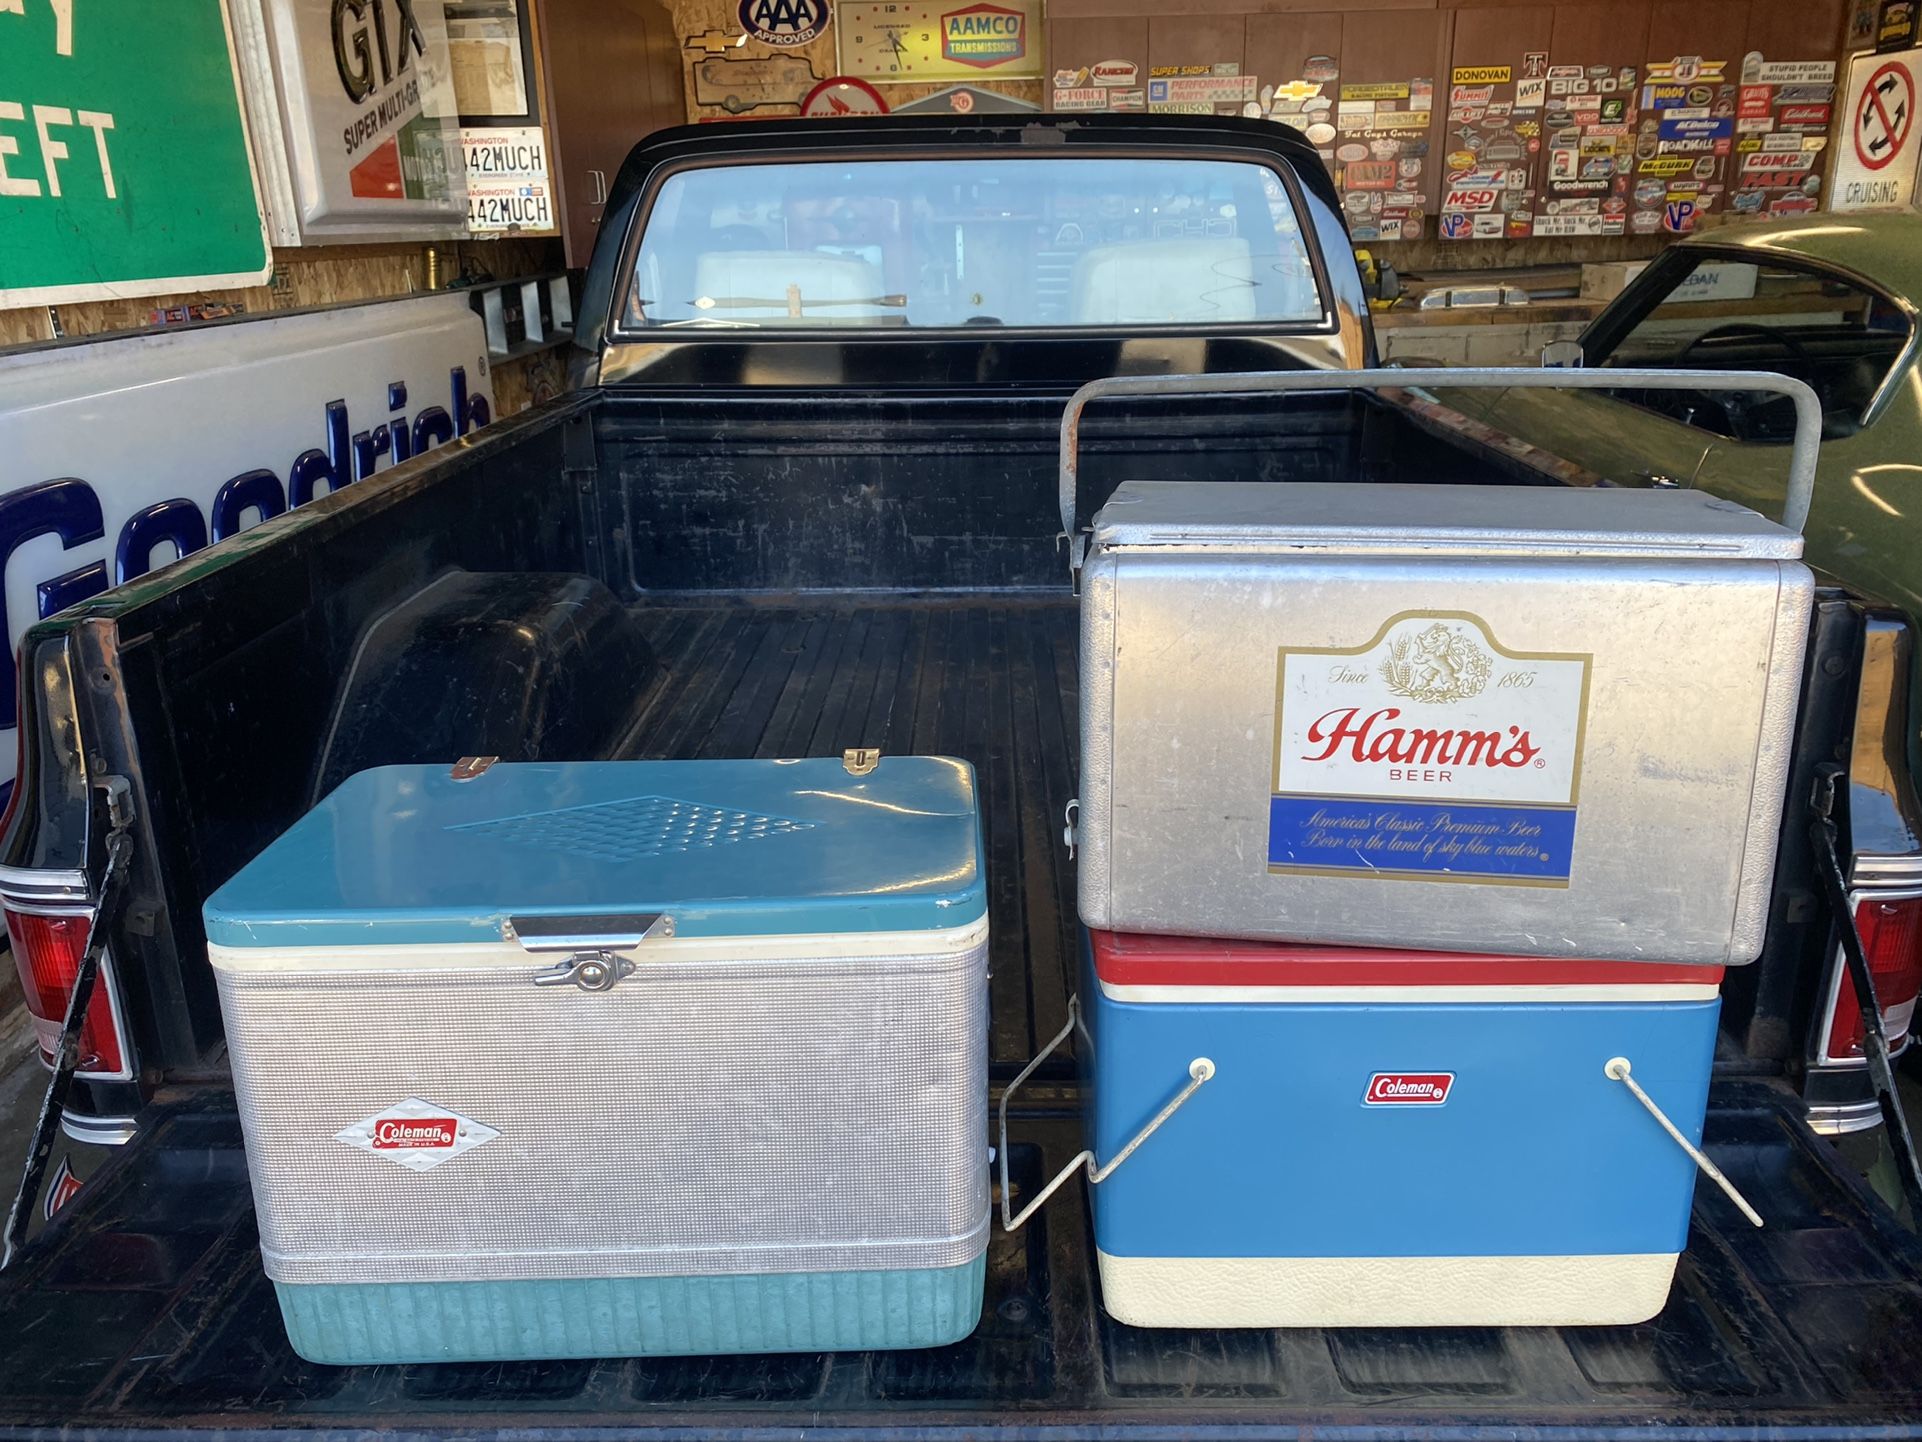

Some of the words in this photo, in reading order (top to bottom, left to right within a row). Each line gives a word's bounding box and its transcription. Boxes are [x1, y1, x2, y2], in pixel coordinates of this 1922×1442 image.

[885, 5, 896, 13] 12
[949, 16, 1018, 35] AAMCO
[754, 28, 815, 45] APPROVED
[951, 41, 1017, 53] TRANSMISSIONS
[1151, 67, 1178, 77] SUPER
[1181, 65, 1212, 75] SHOPS
[1455, 69, 1509, 81] DONOVAN
[1769, 65, 1796, 73] STUPID
[1799, 64, 1827, 72] PEOPLE
[1171, 78, 1255, 91] PERFORMANCE
[1519, 81, 1543, 97] WIX
[1551, 79, 1590, 95] BIG
[1592, 77, 1618, 93] 10
[1055, 89, 1105, 101] G-FORCE
[1112, 95, 1143, 103] CHAMPION
[1171, 91, 1206, 100] PARTS
[1656, 87, 1686, 98] MOOG
[1055, 101, 1085, 109] RACING
[1086, 100, 1106, 108] GEAR
[1151, 103, 1213, 114] MORRISON
[1577, 112, 1599, 121] VDO
[1675, 121, 1720, 130] ACDelco
[344, 111, 378, 155] SUPER
[1658, 139, 1714, 155] ROADKILL
[1748, 154, 1798, 166] COMP
[1553, 179, 1609, 190] Goodwrench
[1743, 172, 1808, 187] FAST
[1447, 191, 1495, 205] MSD
[1846, 180, 1899, 204] CRUISING
[1668, 200, 1694, 231] VP
[1381, 221, 1400, 233] WIX
[1443, 214, 1466, 237] VP
[1328, 664, 1370, 685] Since
[1497, 671, 1538, 689] 1865
[1301, 707, 1542, 768] Hamm's
[1390, 769, 1453, 782] BEER
[1300, 808, 1372, 831] America's
[1375, 811, 1424, 833] Classic
[1426, 812, 1501, 835] Premium
[1501, 815, 1543, 837] Beer
[1301, 829, 1343, 848] Born
[1346, 834, 1362, 850] in
[1365, 834, 1388, 851] the
[1388, 834, 1421, 852] land
[1419, 836, 1438, 863] of
[1439, 835, 1462, 863] sky
[1463, 836, 1492, 856] blue
[1375, 1078, 1435, 1098] Coleman
[380, 1122, 442, 1144] Coleman
